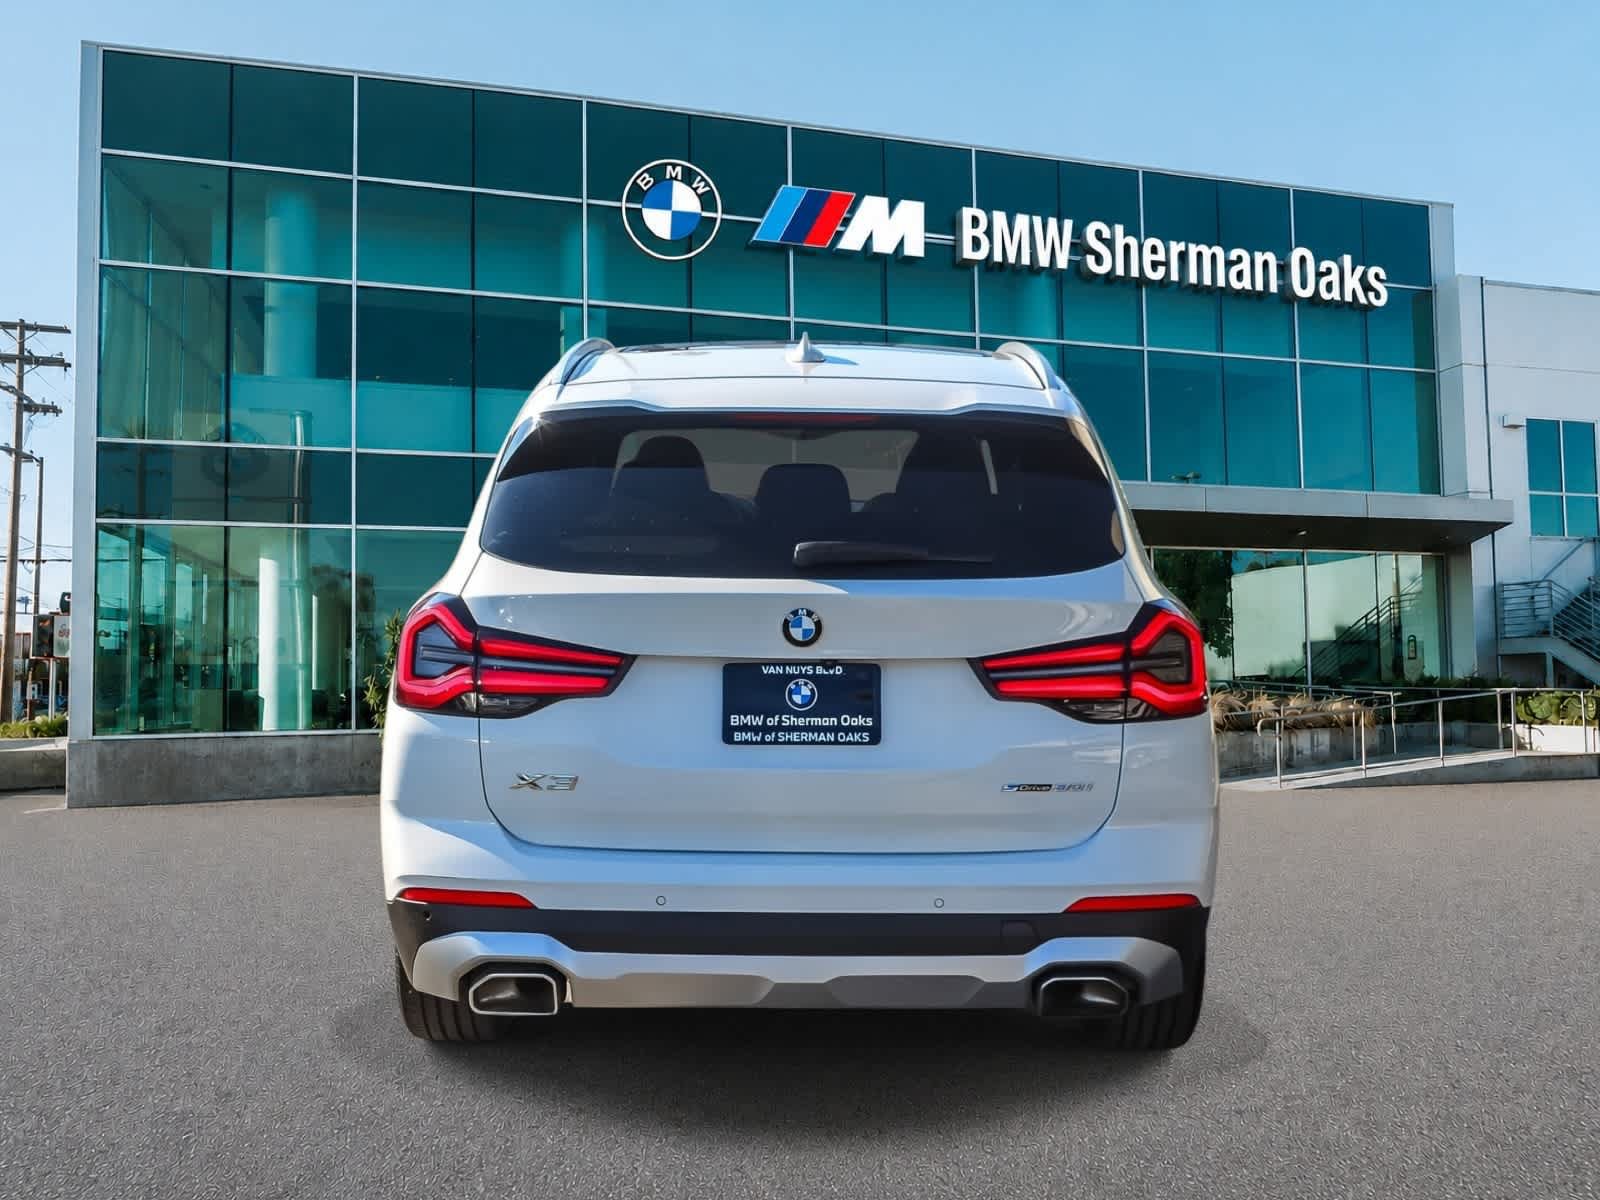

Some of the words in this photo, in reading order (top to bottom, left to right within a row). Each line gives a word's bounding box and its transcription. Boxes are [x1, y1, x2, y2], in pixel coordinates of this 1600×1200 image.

[834, 194, 925, 258] M
[959, 206, 1074, 271] BMW
[1083, 220, 1280, 294] Sherman
[1287, 246, 1389, 308] Oaks
[761, 665, 784, 675] VAN
[785, 665, 814, 675] NUYS
[730, 714, 764, 726] BMW
[766, 714, 780, 726] of
[781, 714, 838, 726] Sherman
[840, 714, 873, 726] Oaks
[733, 731, 762, 742] BMW
[764, 731, 776, 742] of
[777, 731, 835, 742] SHERMAN
[837, 731, 870, 742] OAKS
[509, 773, 579, 791] X3
